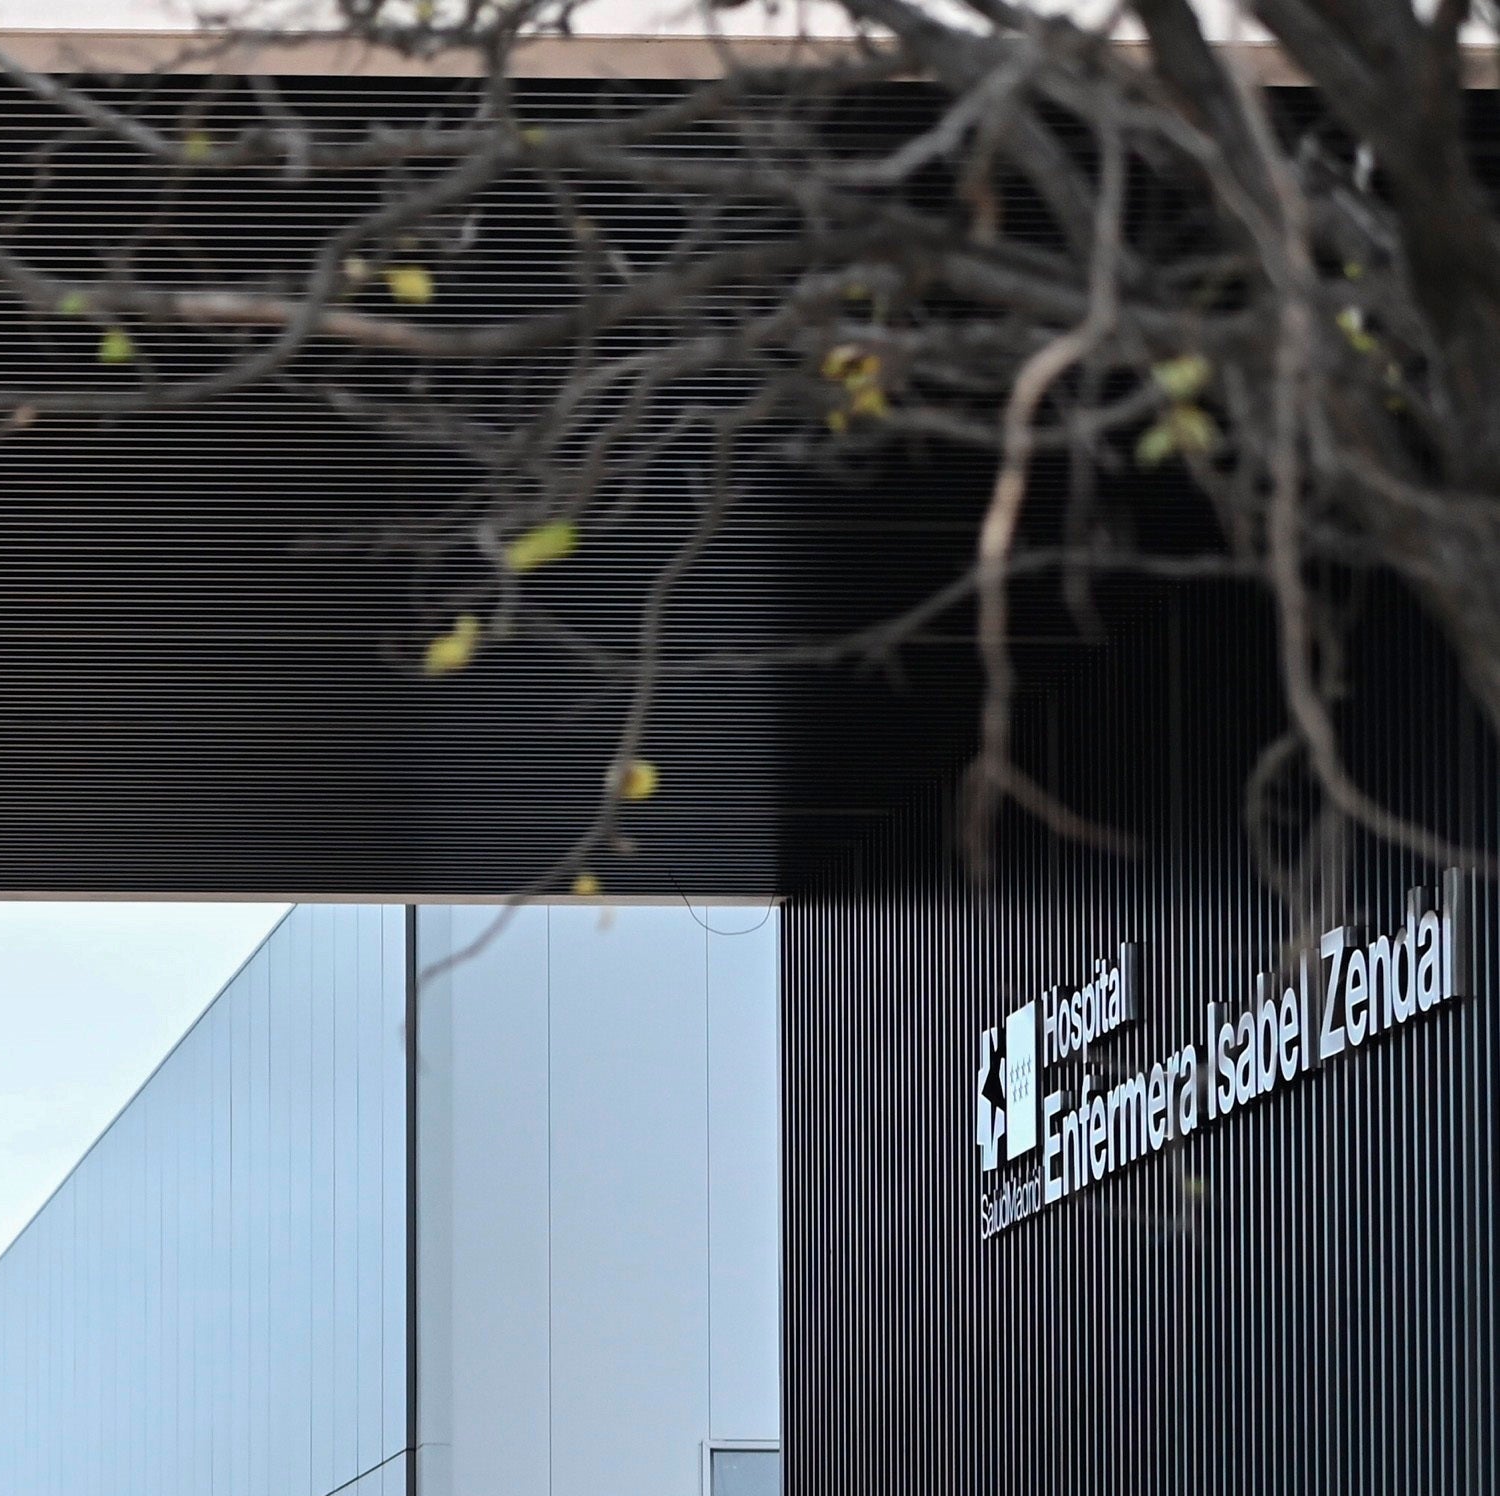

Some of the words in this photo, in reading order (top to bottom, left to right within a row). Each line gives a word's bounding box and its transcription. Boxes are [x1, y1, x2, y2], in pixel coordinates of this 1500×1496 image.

[1043, 942, 1127, 1068] Hospital
[1043, 1044, 1198, 1205] Enfermera
[1207, 947, 1310, 1121] Isabel
[1320, 866, 1452, 1060] Zendal
